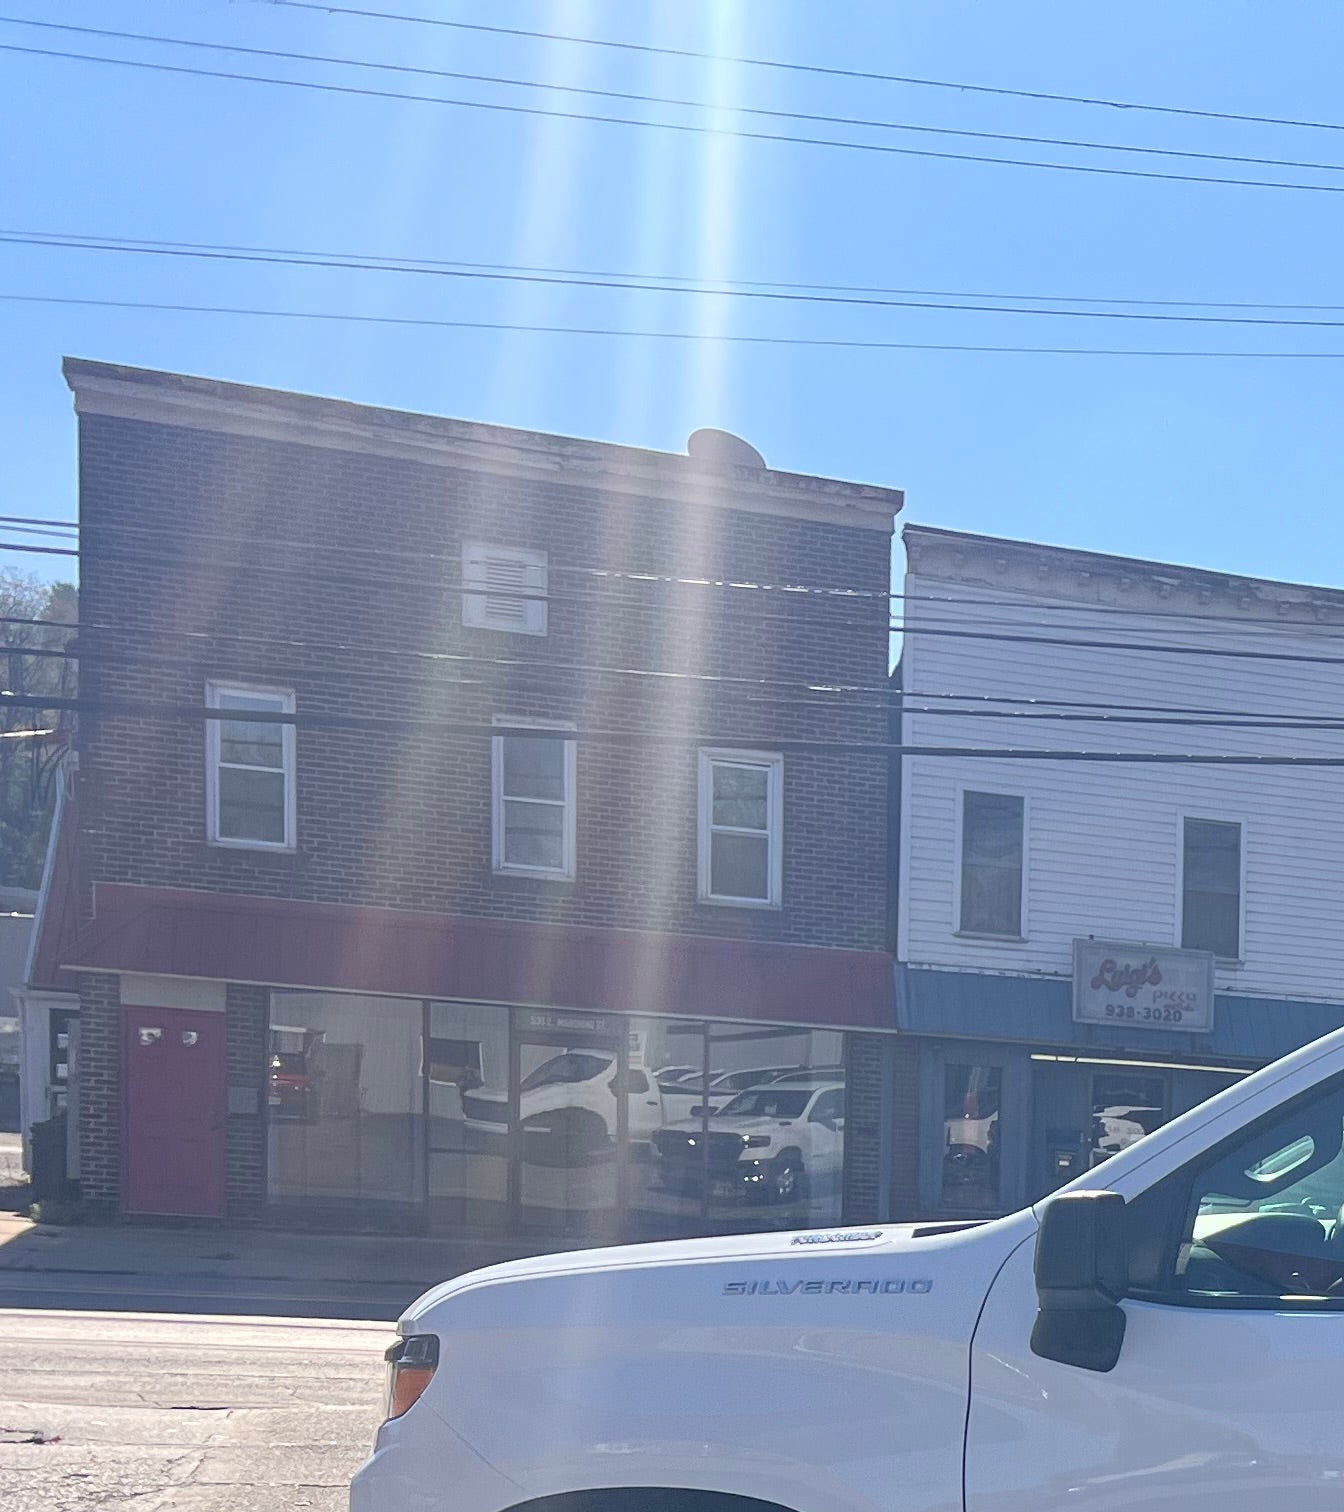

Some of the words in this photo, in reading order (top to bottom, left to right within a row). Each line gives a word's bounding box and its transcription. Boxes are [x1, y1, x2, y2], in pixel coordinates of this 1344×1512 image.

[1091, 956, 1162, 998] Luigi's
[1105, 1004, 1182, 1022] 938-3020
[722, 1279, 933, 1296] SILVERADO
